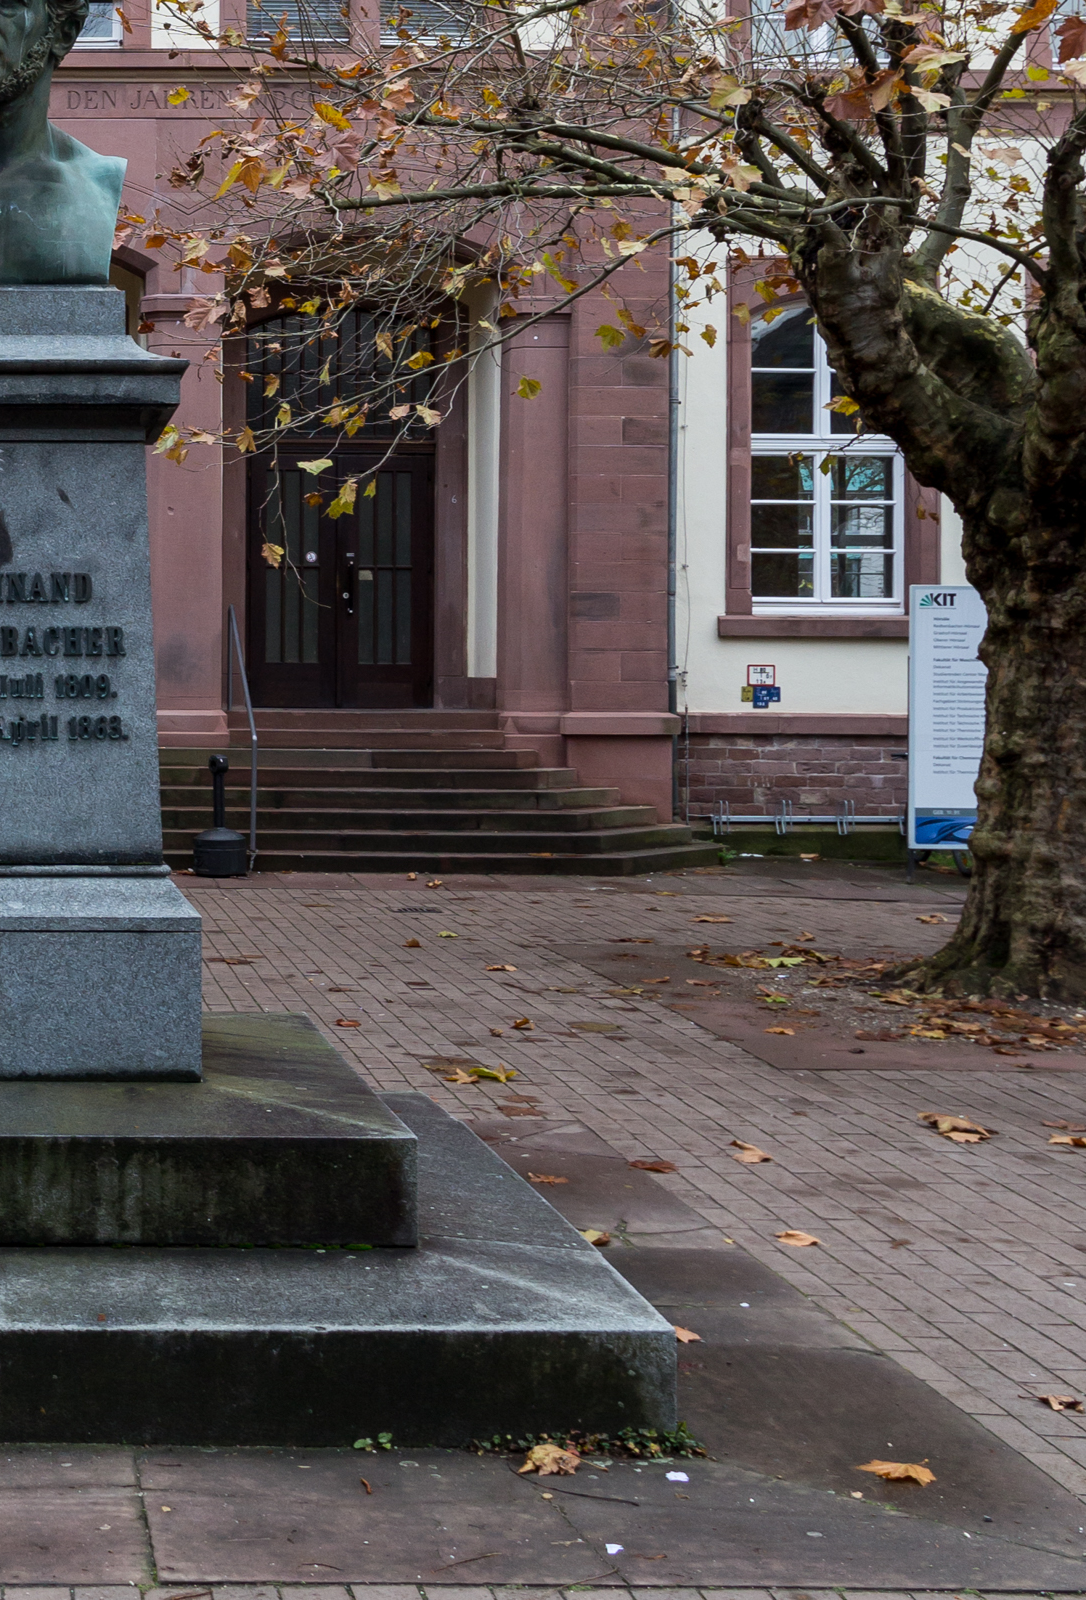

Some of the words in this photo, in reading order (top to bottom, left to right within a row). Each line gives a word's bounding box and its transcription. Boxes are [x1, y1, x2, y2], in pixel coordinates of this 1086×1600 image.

[66, 89, 117, 110] DEN
[451, 494, 458, 504] 6
[930, 592, 957, 607] KIT
[54, 673, 119, 699] 1809.
[68, 715, 129, 741] 1863.
